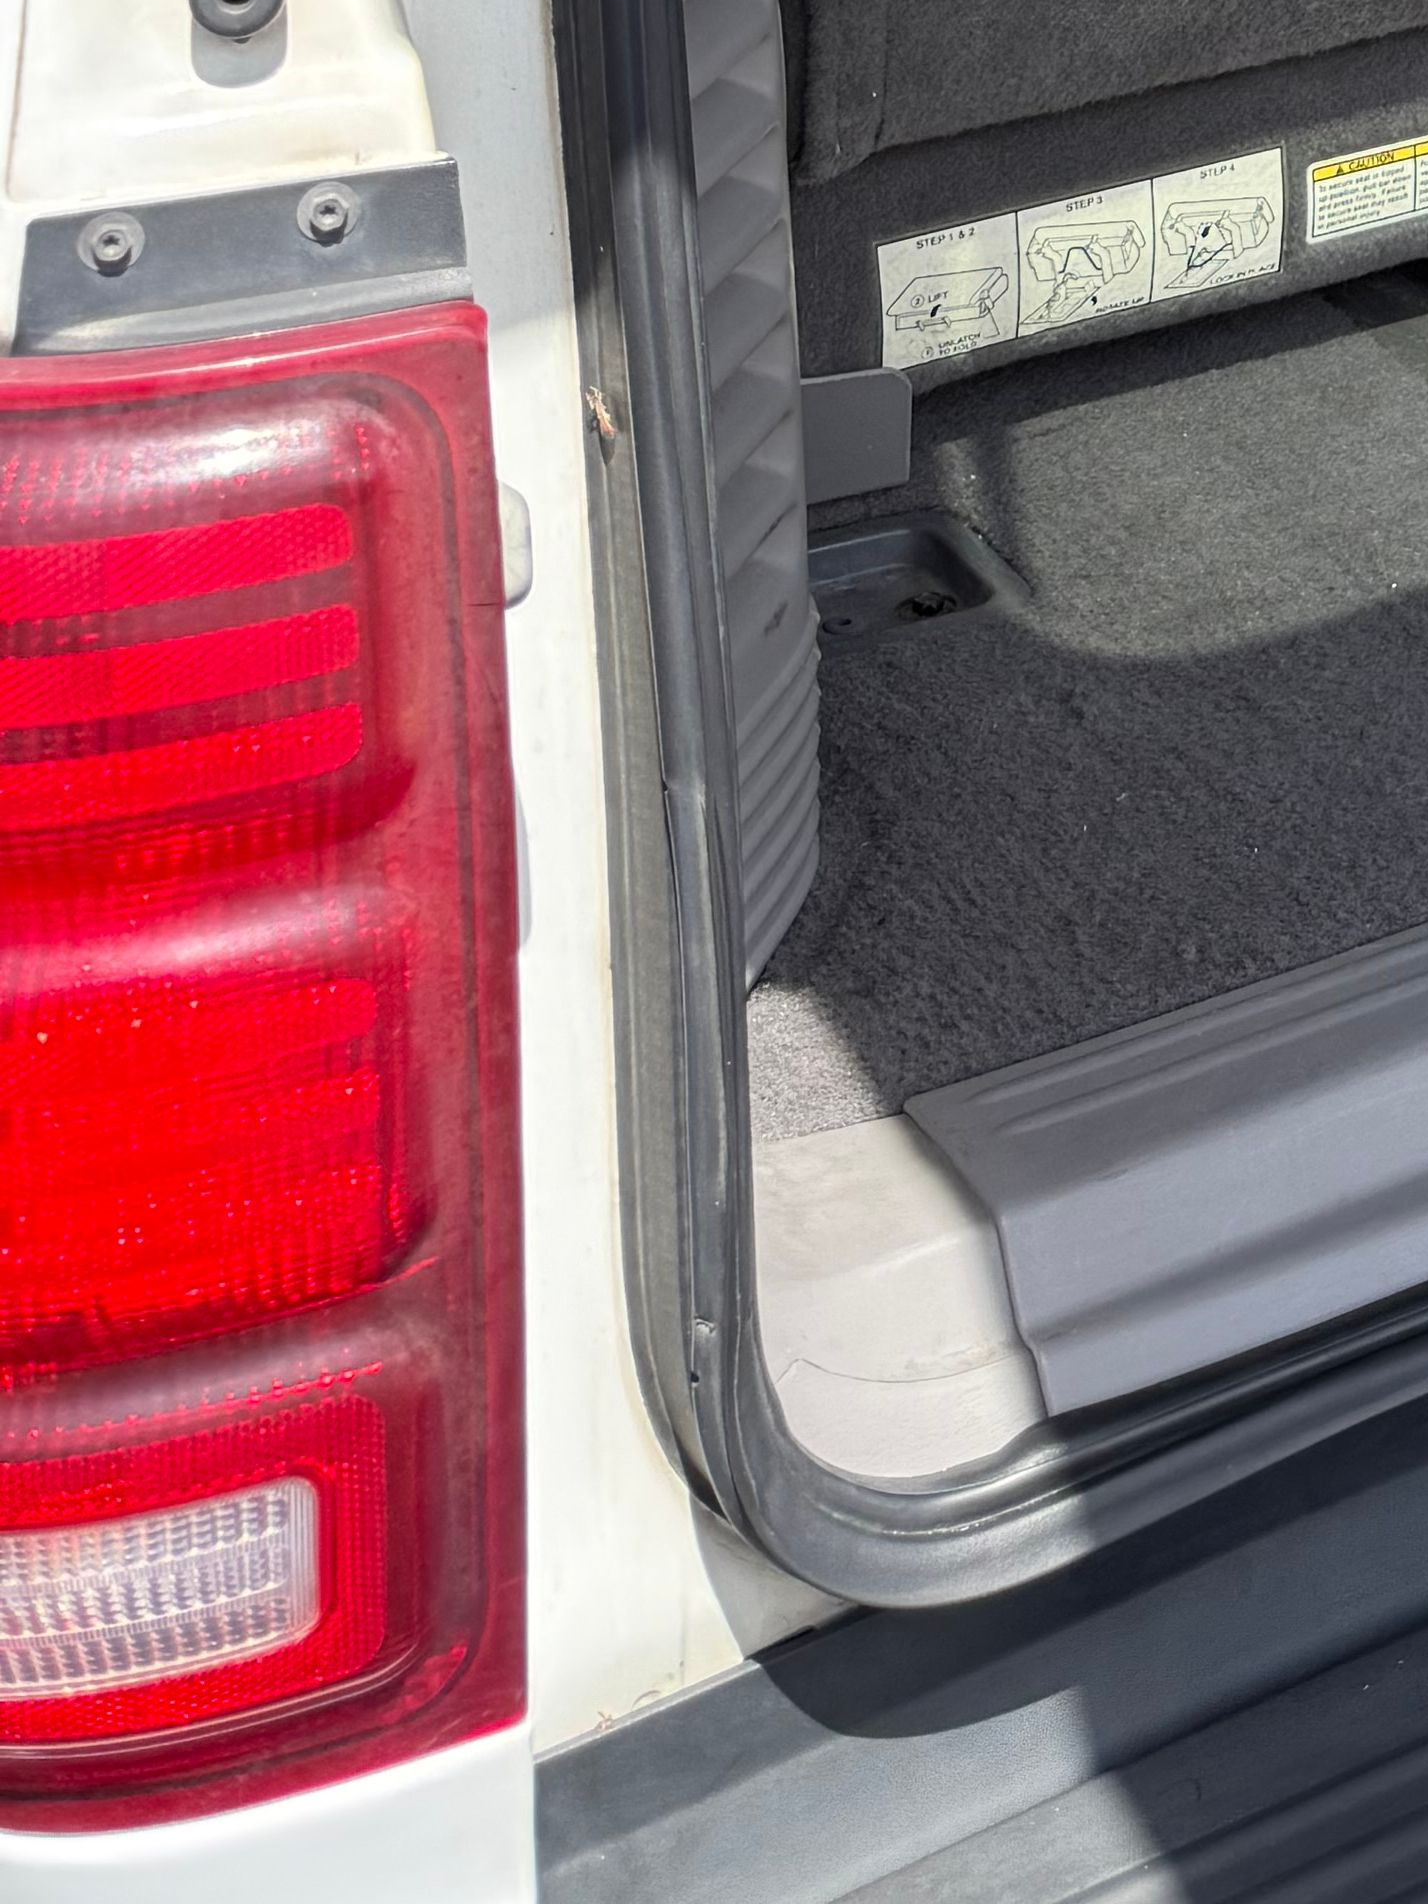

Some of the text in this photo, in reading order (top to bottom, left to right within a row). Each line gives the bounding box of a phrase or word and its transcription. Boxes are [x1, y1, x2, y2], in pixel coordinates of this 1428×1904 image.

[1348, 152, 1395, 171] CAUTION
[1200, 165, 1227, 179] STEP
[1066, 197, 1095, 213] STEP
[916, 234, 946, 250] STEP
[928, 291, 948, 304] LIFT
